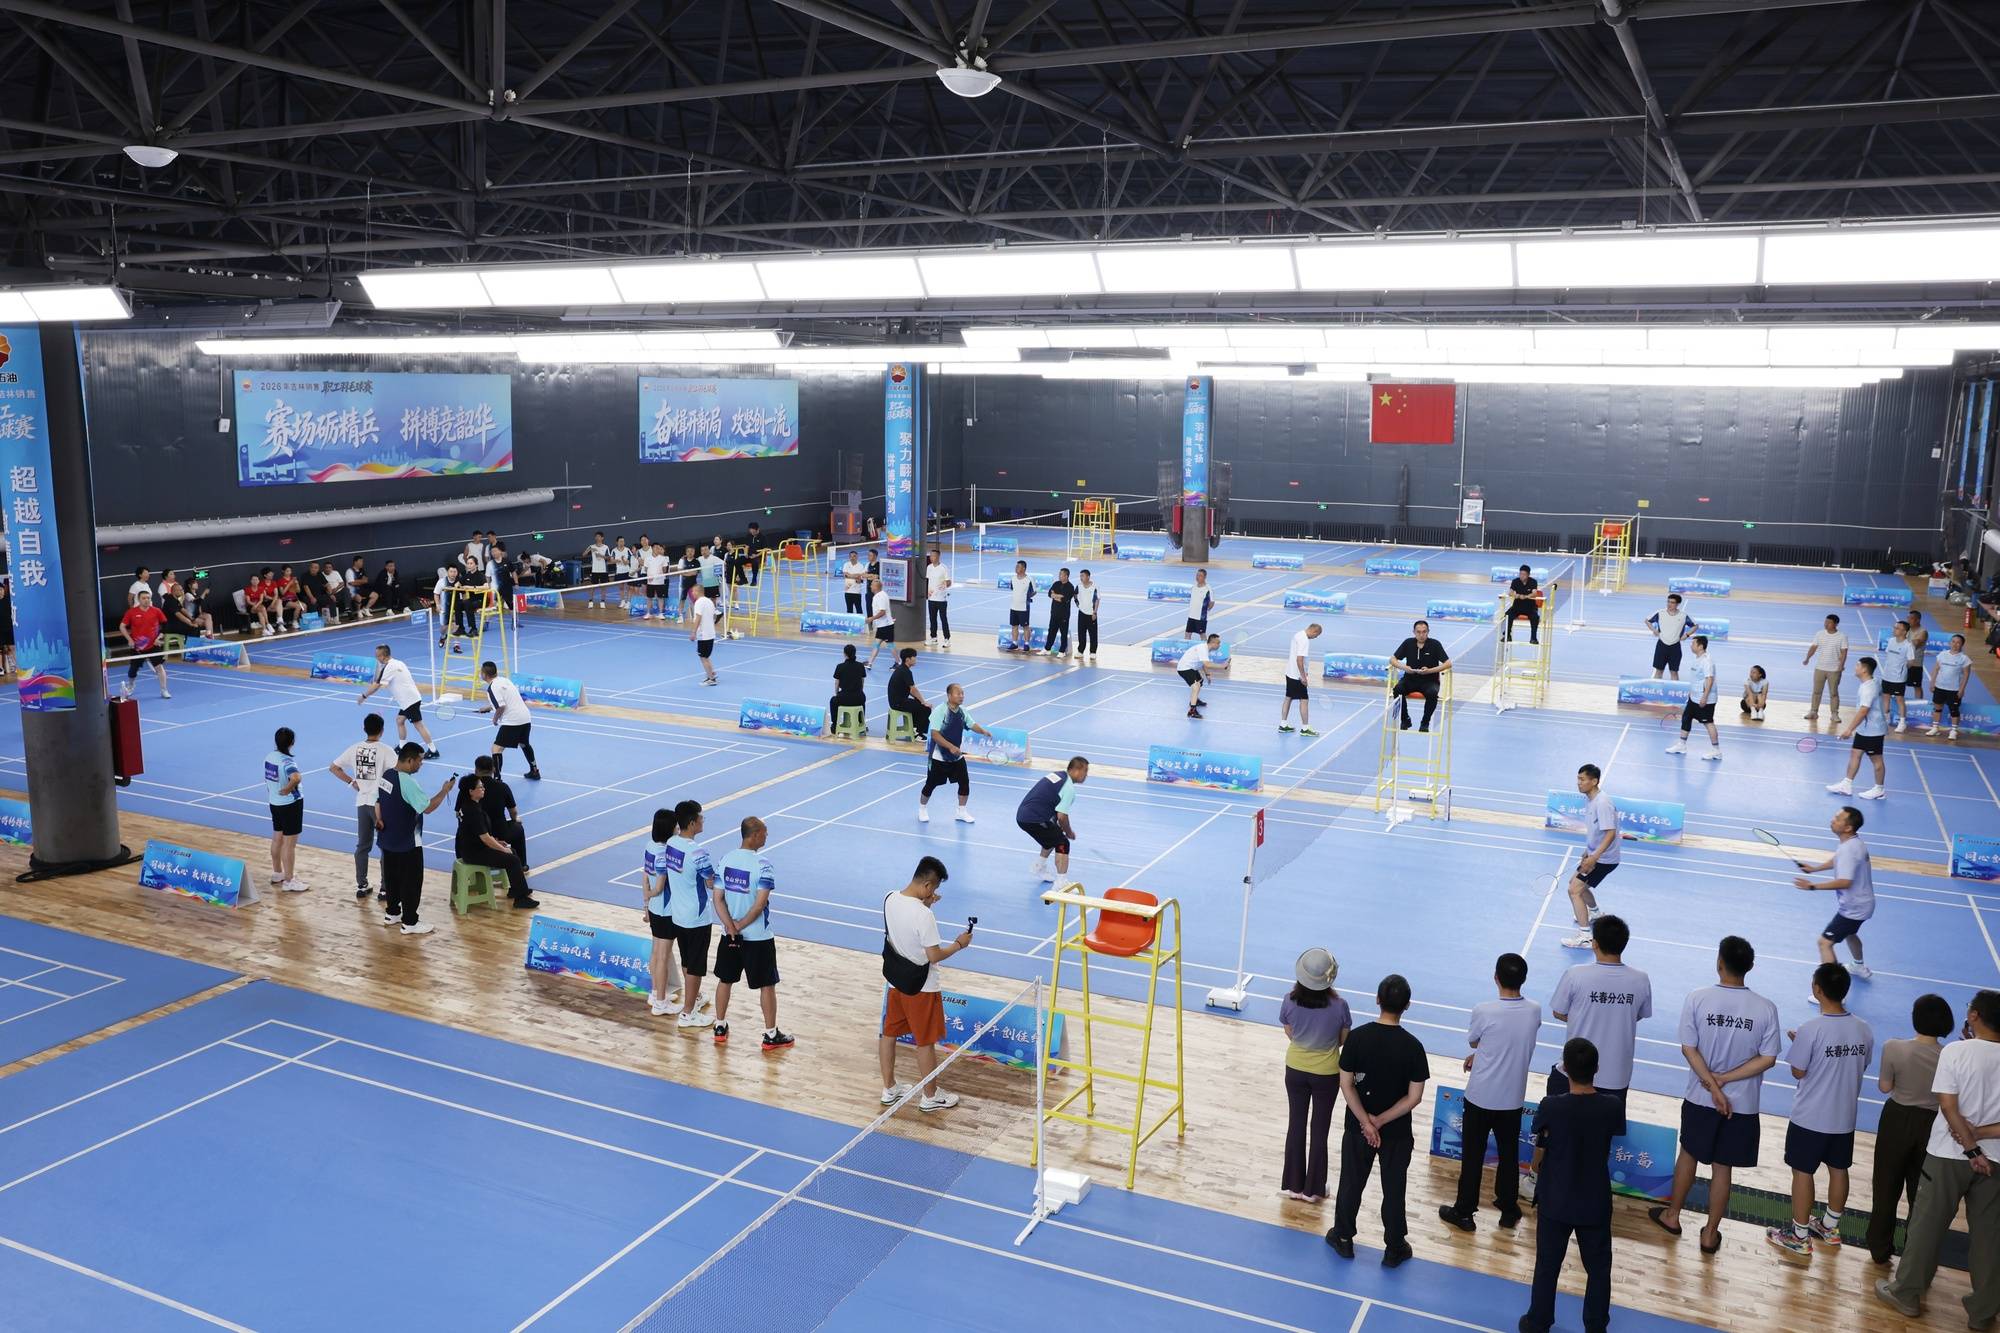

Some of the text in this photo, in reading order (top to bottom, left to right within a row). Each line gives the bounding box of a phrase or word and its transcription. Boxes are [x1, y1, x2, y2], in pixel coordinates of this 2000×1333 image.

[261, 399, 497, 458] 赛场砺精兵 拼搏竞韶华
[651, 399, 791, 446] 奋楫开新局 攻坚创一流
[10, 465, 47, 587] 超越自我
[1589, 990, 1635, 1006] 长春分公司
[1706, 1012, 1753, 1033] 长春分公司
[1825, 1043, 1866, 1058] 长春分公司
